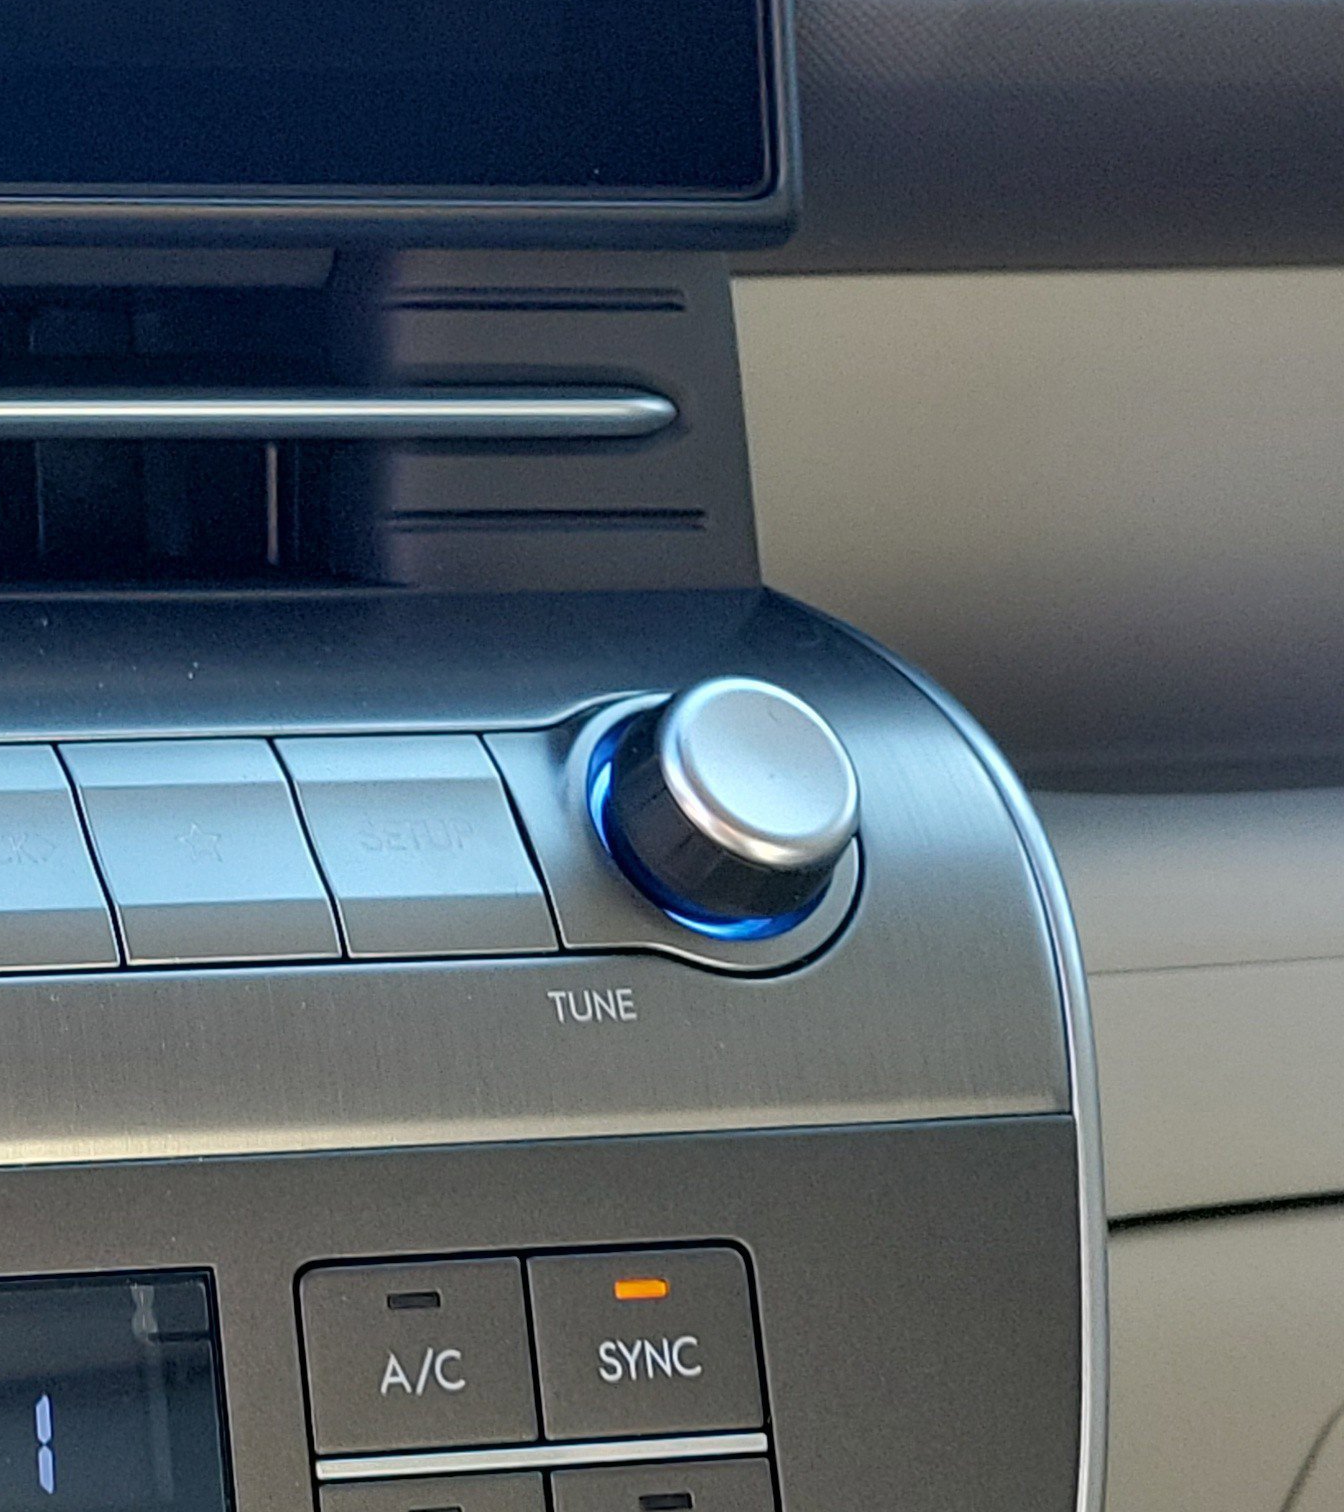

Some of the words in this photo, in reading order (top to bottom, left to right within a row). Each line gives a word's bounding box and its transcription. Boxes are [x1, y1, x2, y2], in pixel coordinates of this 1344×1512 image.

[547, 988, 637, 1023] TUNE
[380, 1347, 466, 1395] A/C
[599, 1336, 703, 1383] SYNC
